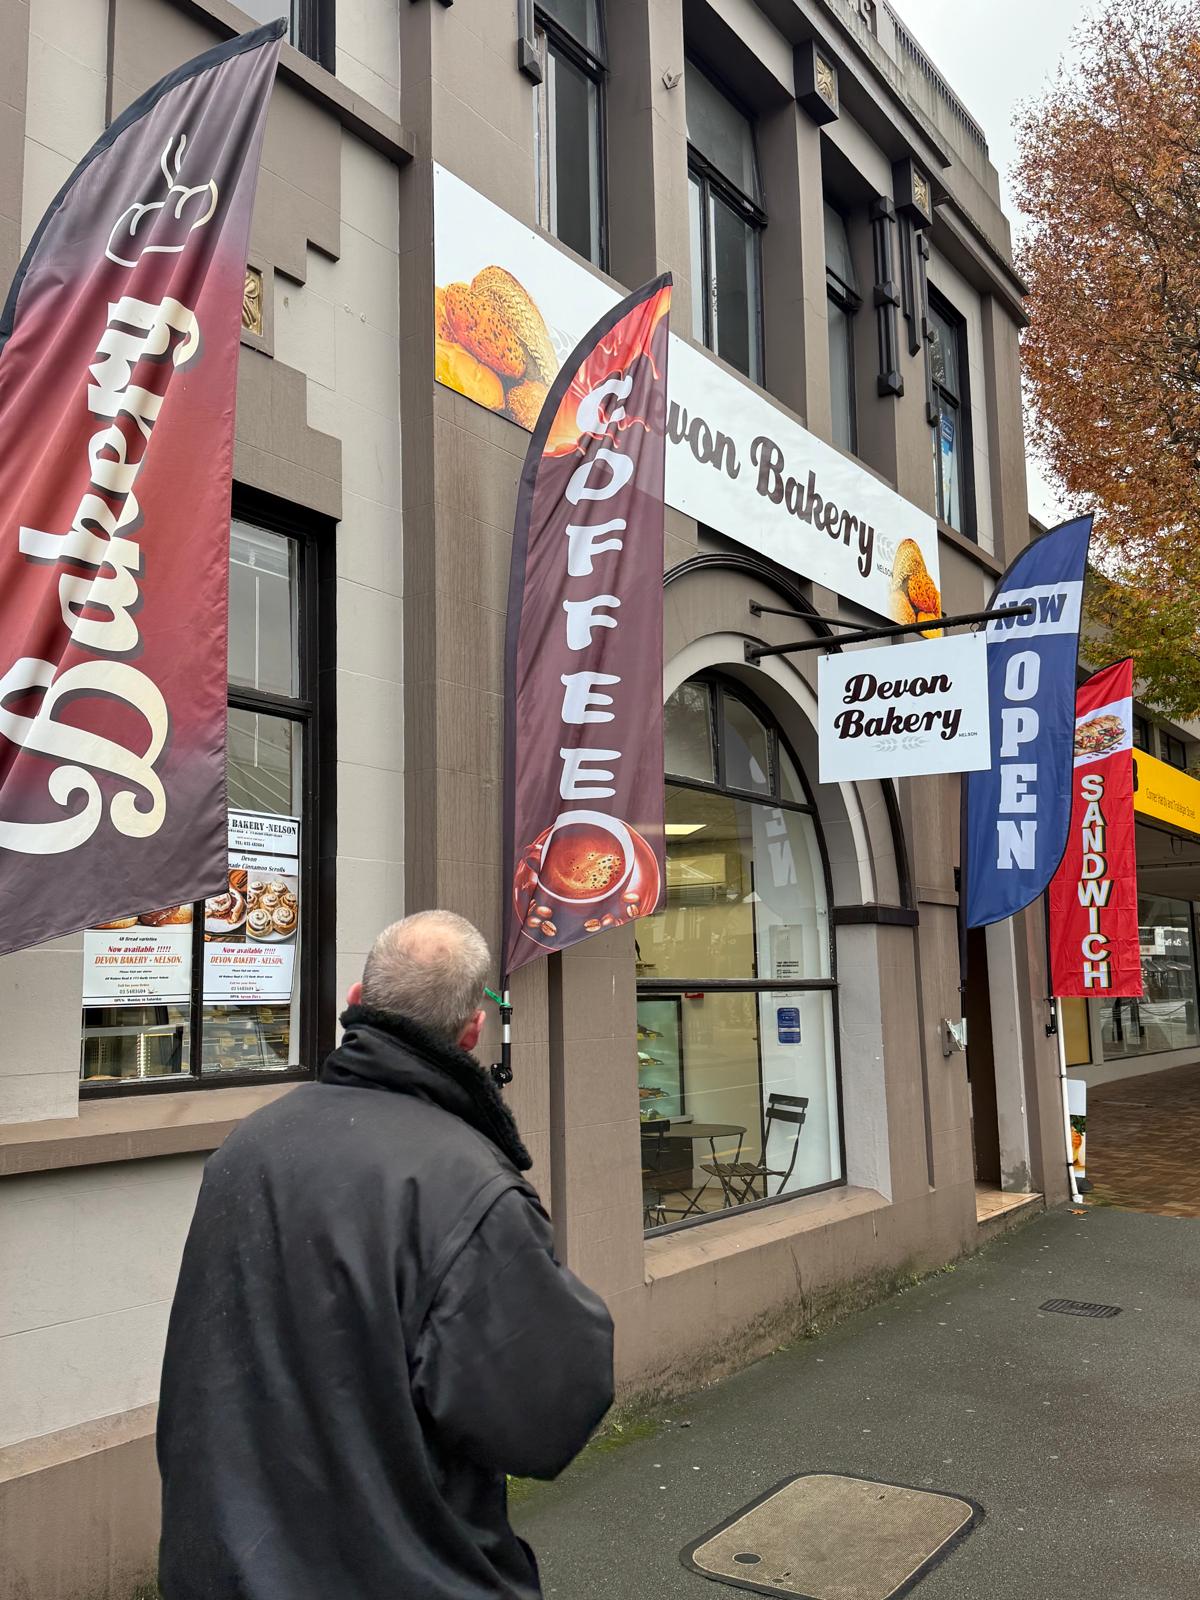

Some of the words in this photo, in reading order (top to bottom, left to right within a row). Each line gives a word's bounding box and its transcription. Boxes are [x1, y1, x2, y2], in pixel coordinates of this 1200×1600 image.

[666, 400, 741, 479] von
[750, 436, 874, 578] Bakery
[0, 297, 199, 855] Bakery
[560, 375, 634, 800] COFFEE
[994, 594, 1067, 630] NOW
[842, 673, 952, 704] Devon
[834, 707, 962, 740] Bakery
[997, 651, 1041, 869] OPEN
[232, 819, 264, 831] BAKERY
[1077, 774, 1113, 989] SANDWICH
[94, 956, 119, 964] DEVON
[120, 956, 148, 964] BAKERY
[107, 945, 122, 953] Now
[123, 945, 155, 953] available
